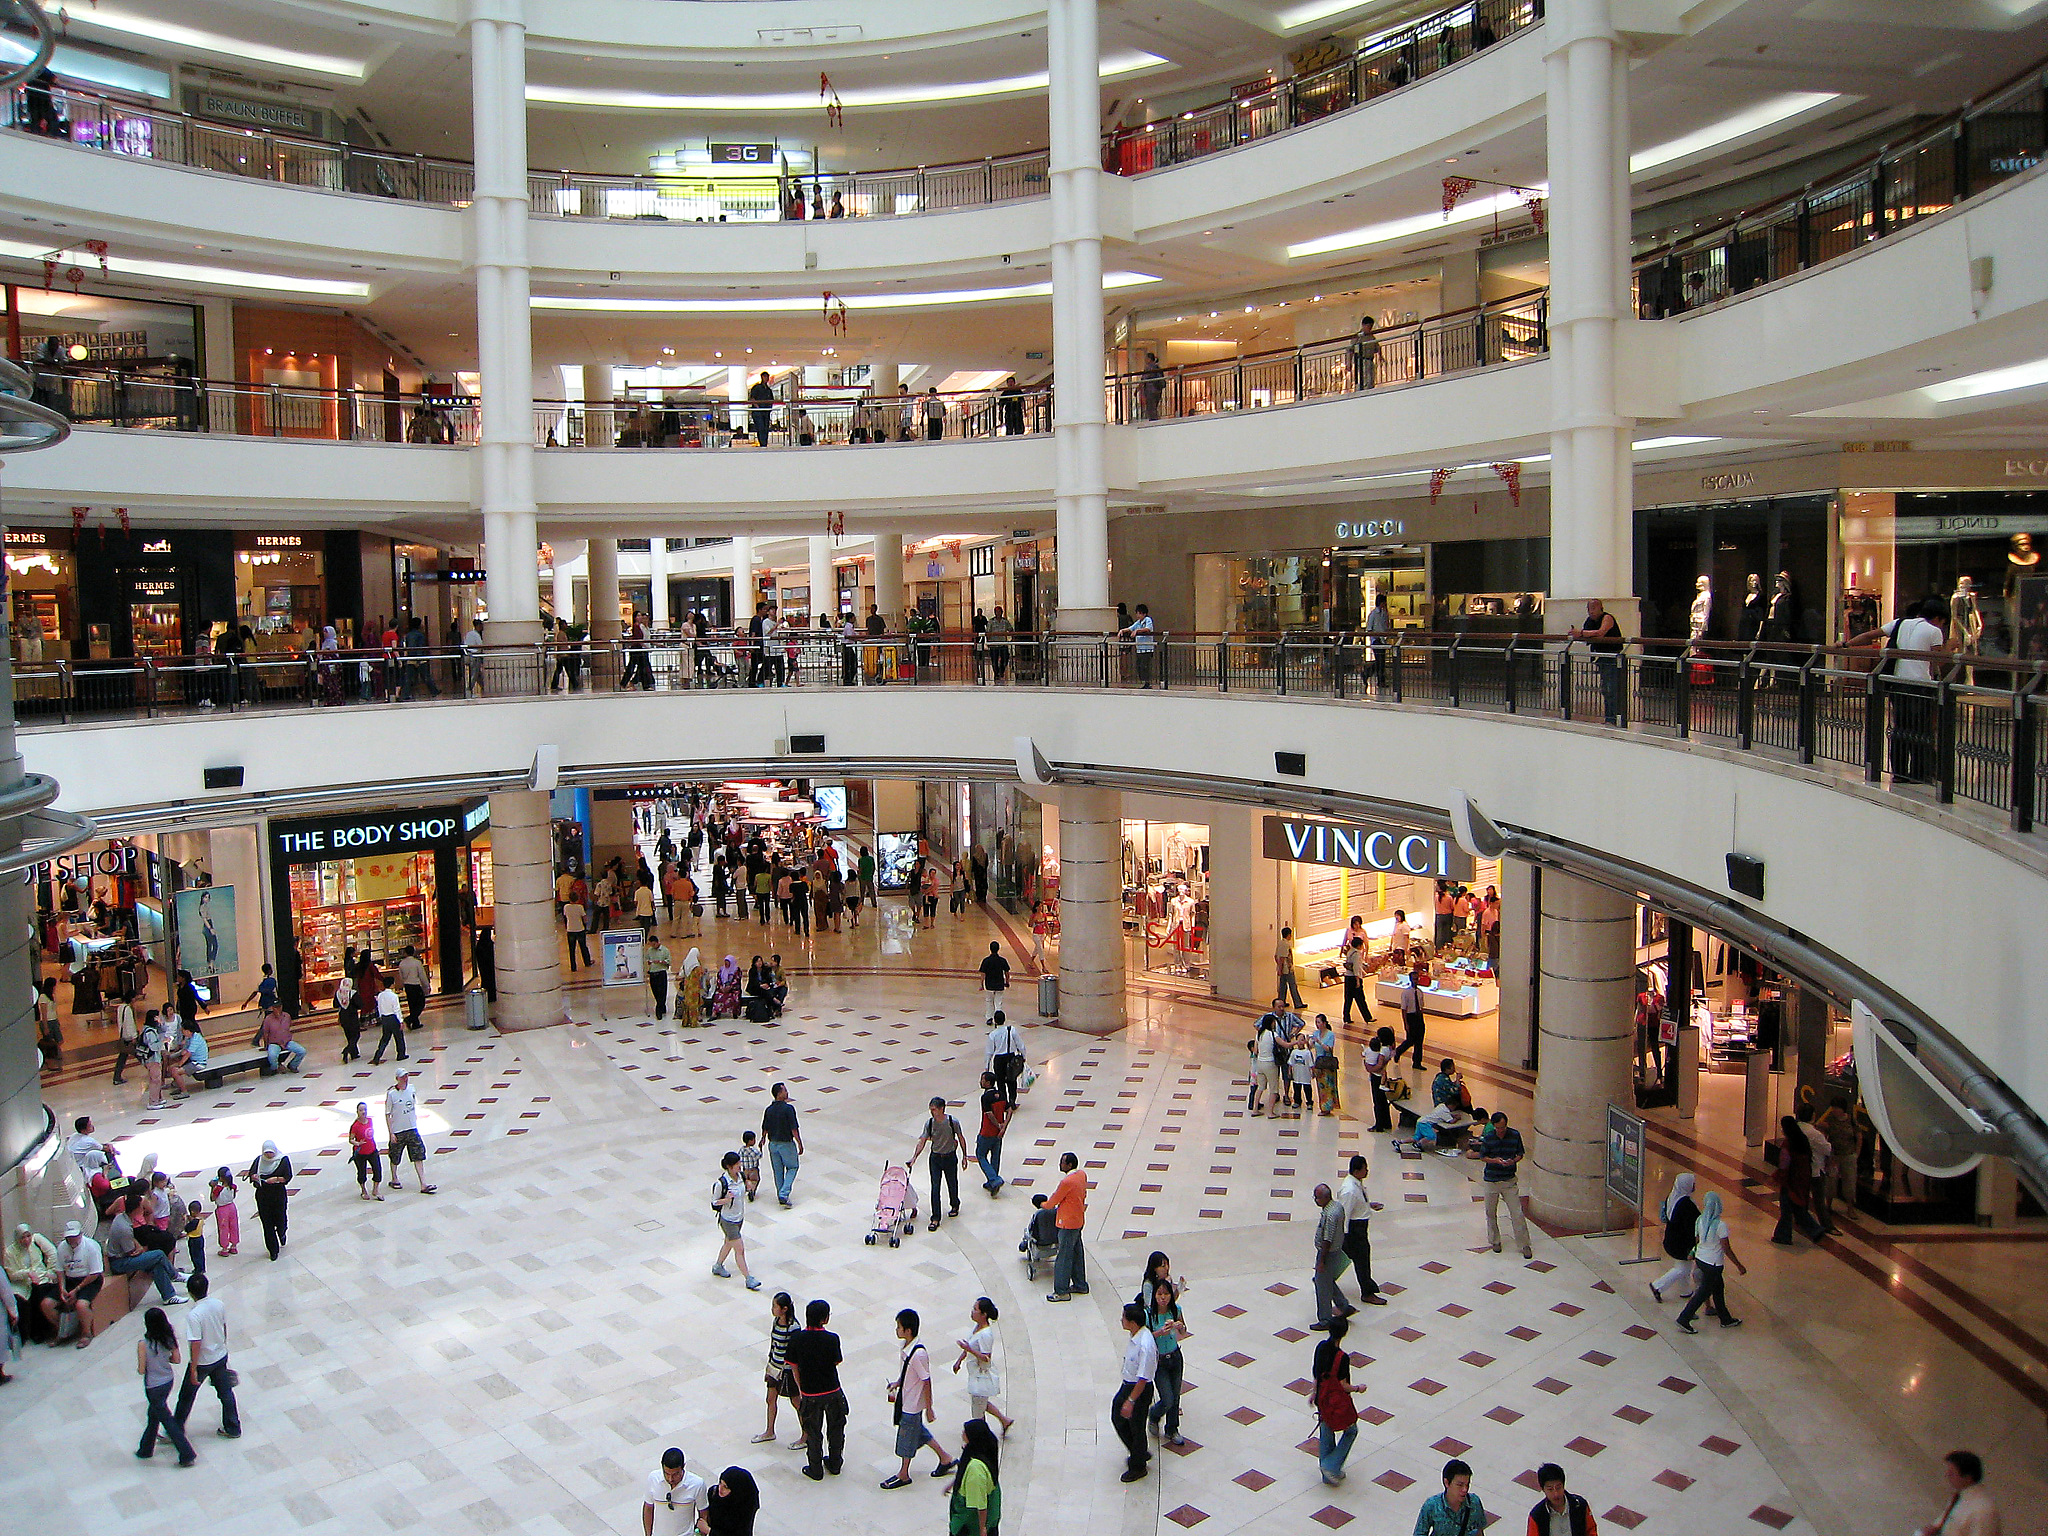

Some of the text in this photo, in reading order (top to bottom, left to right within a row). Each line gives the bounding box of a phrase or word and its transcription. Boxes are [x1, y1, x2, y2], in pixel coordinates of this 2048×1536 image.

[206, 98, 257, 120] BRAUN
[725, 144, 760, 162] 3G
[1701, 471, 1755, 491] ESCADA
[4, 532, 47, 544] ERMÈS
[1334, 519, 1405, 540] GUCCI
[279, 817, 456, 853] THE BODY SHOP
[1282, 822, 1449, 877] VINCCI
[1146, 919, 1206, 955] SALE
